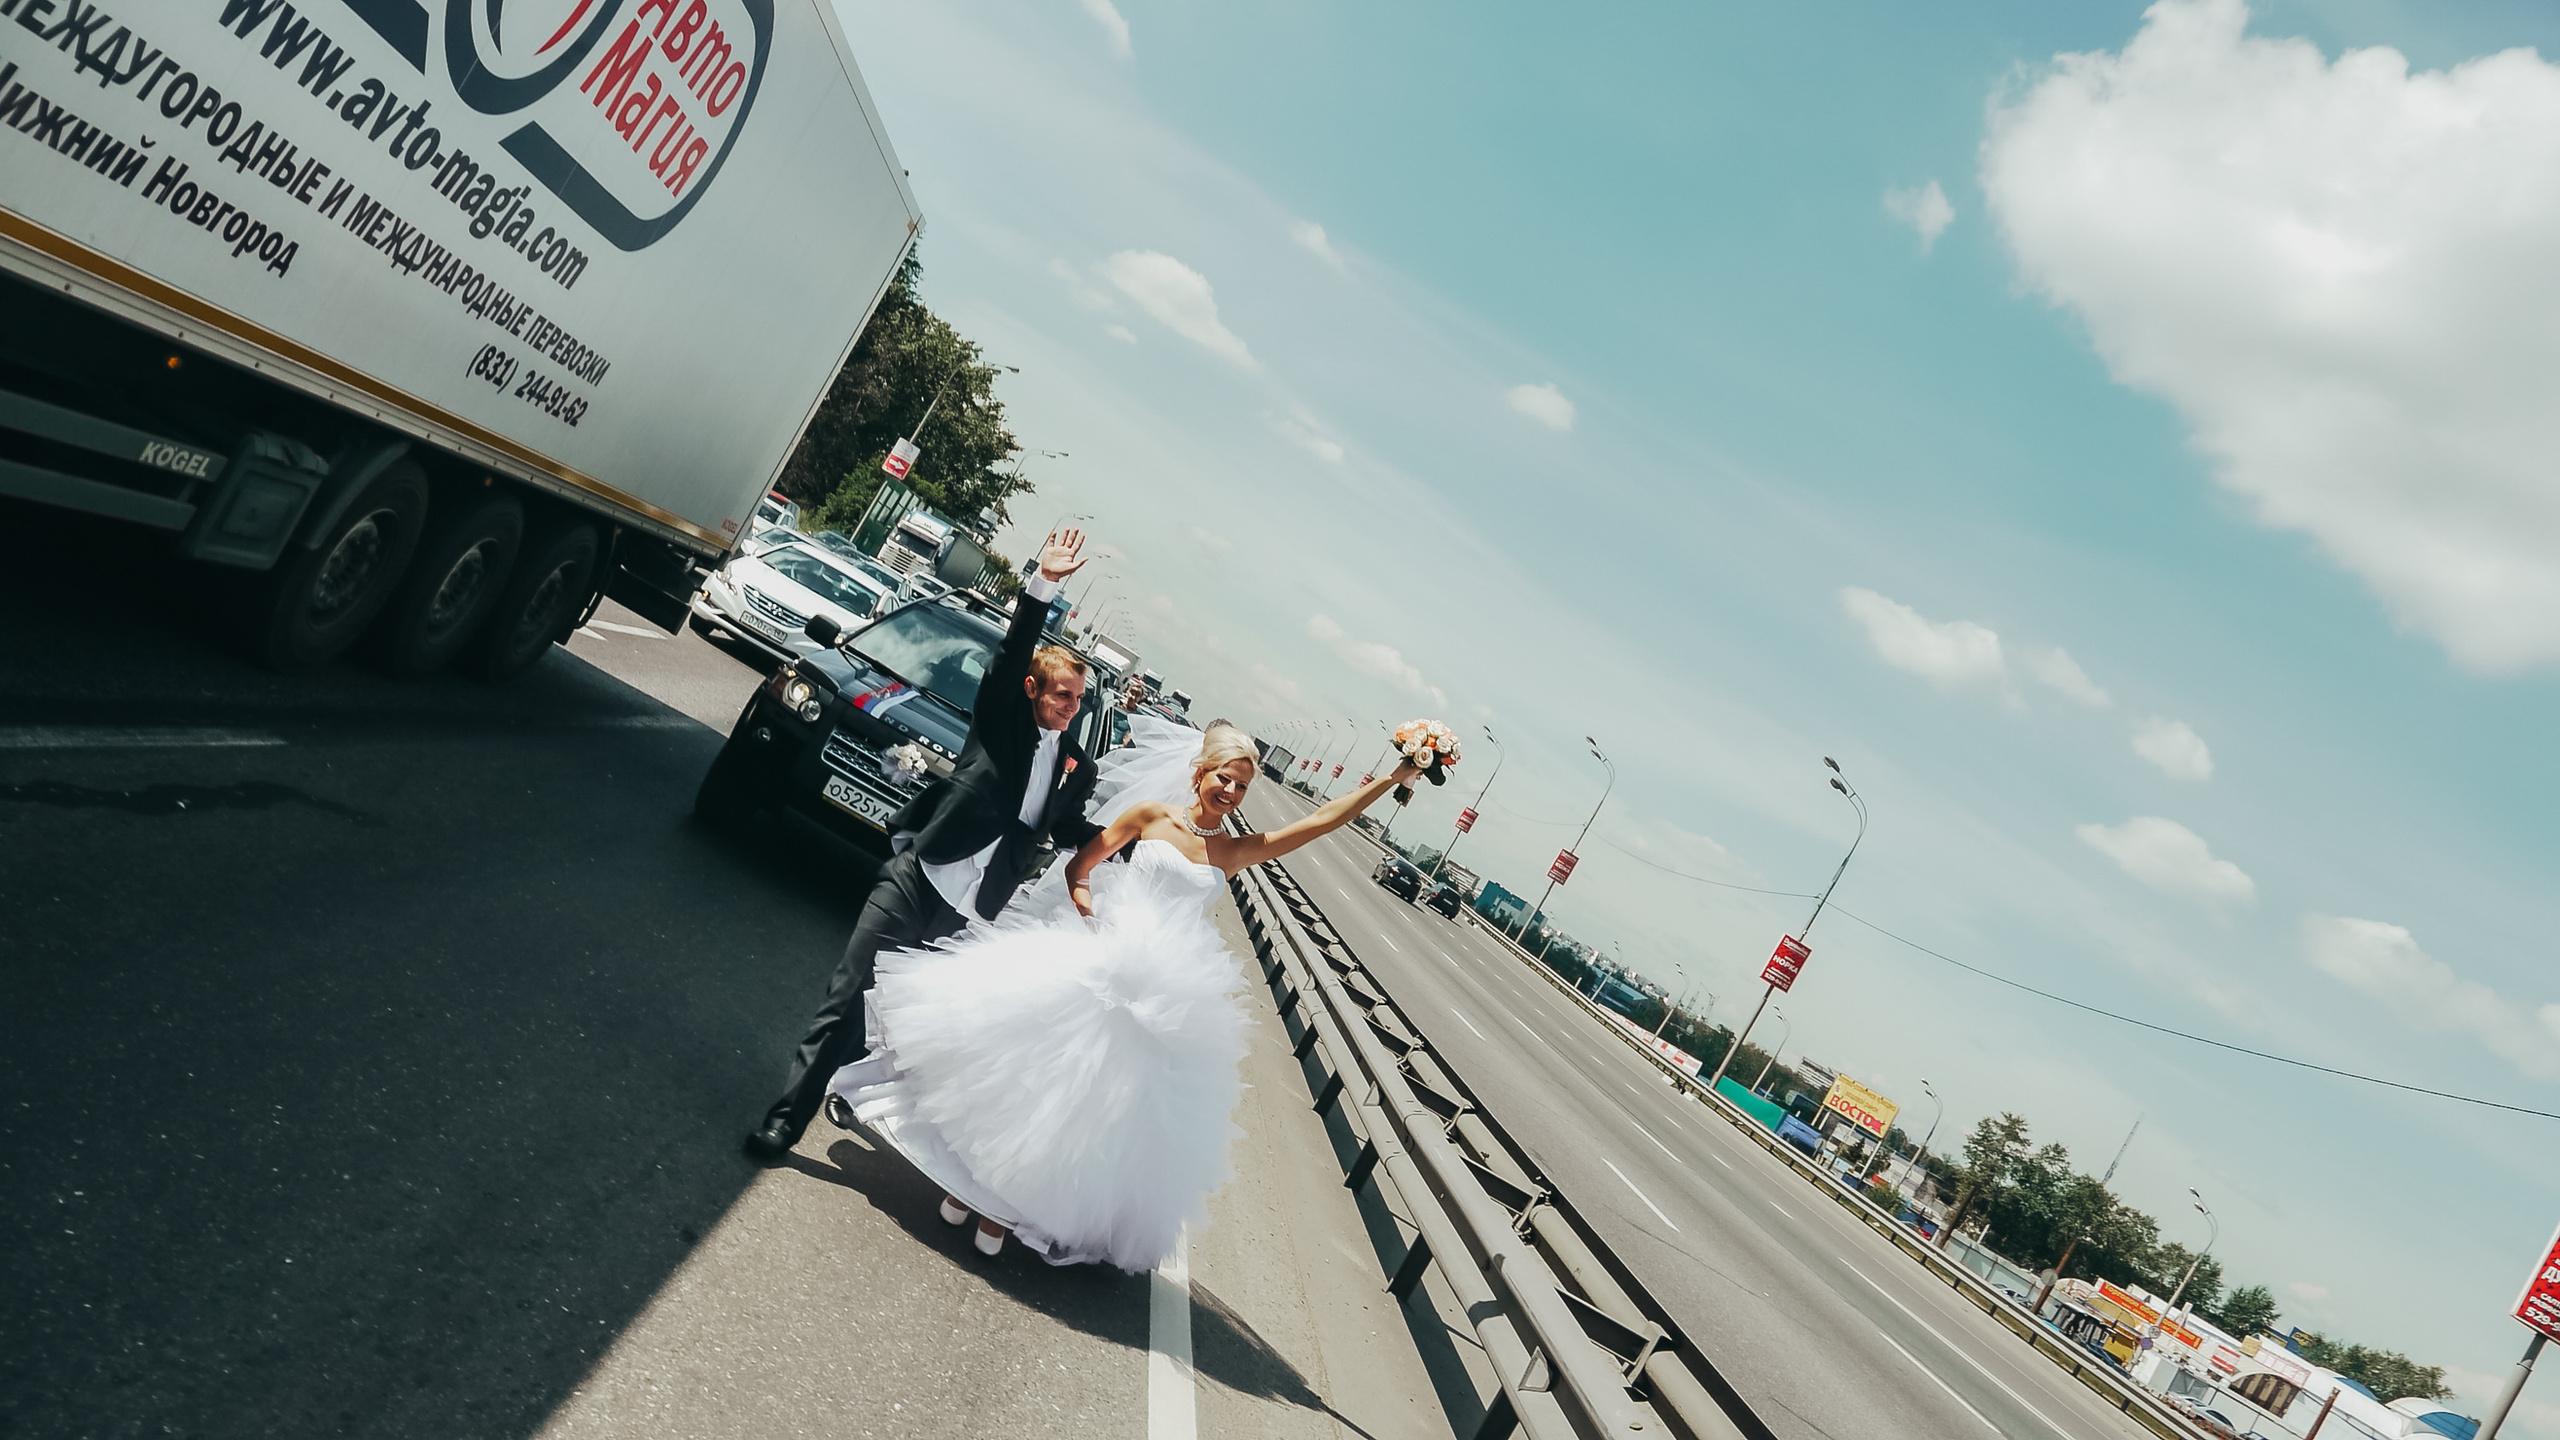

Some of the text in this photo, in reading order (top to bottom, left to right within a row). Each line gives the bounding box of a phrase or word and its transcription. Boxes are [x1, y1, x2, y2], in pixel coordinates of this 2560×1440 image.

[218, 0, 589, 291] www.avto-magia.com
[579, 17, 709, 199] Магия
[0, 0, 611, 388] ЕЖДУГОРОДНЫЕ И МЕЖДУНАРОДНЫЕ ПЕРЕВОЗКИ
[140, 154, 300, 279] Новгород
[465, 342, 589, 429] (831) 244-91-62
[1828, 1094, 1886, 1134] ВОСТОК
